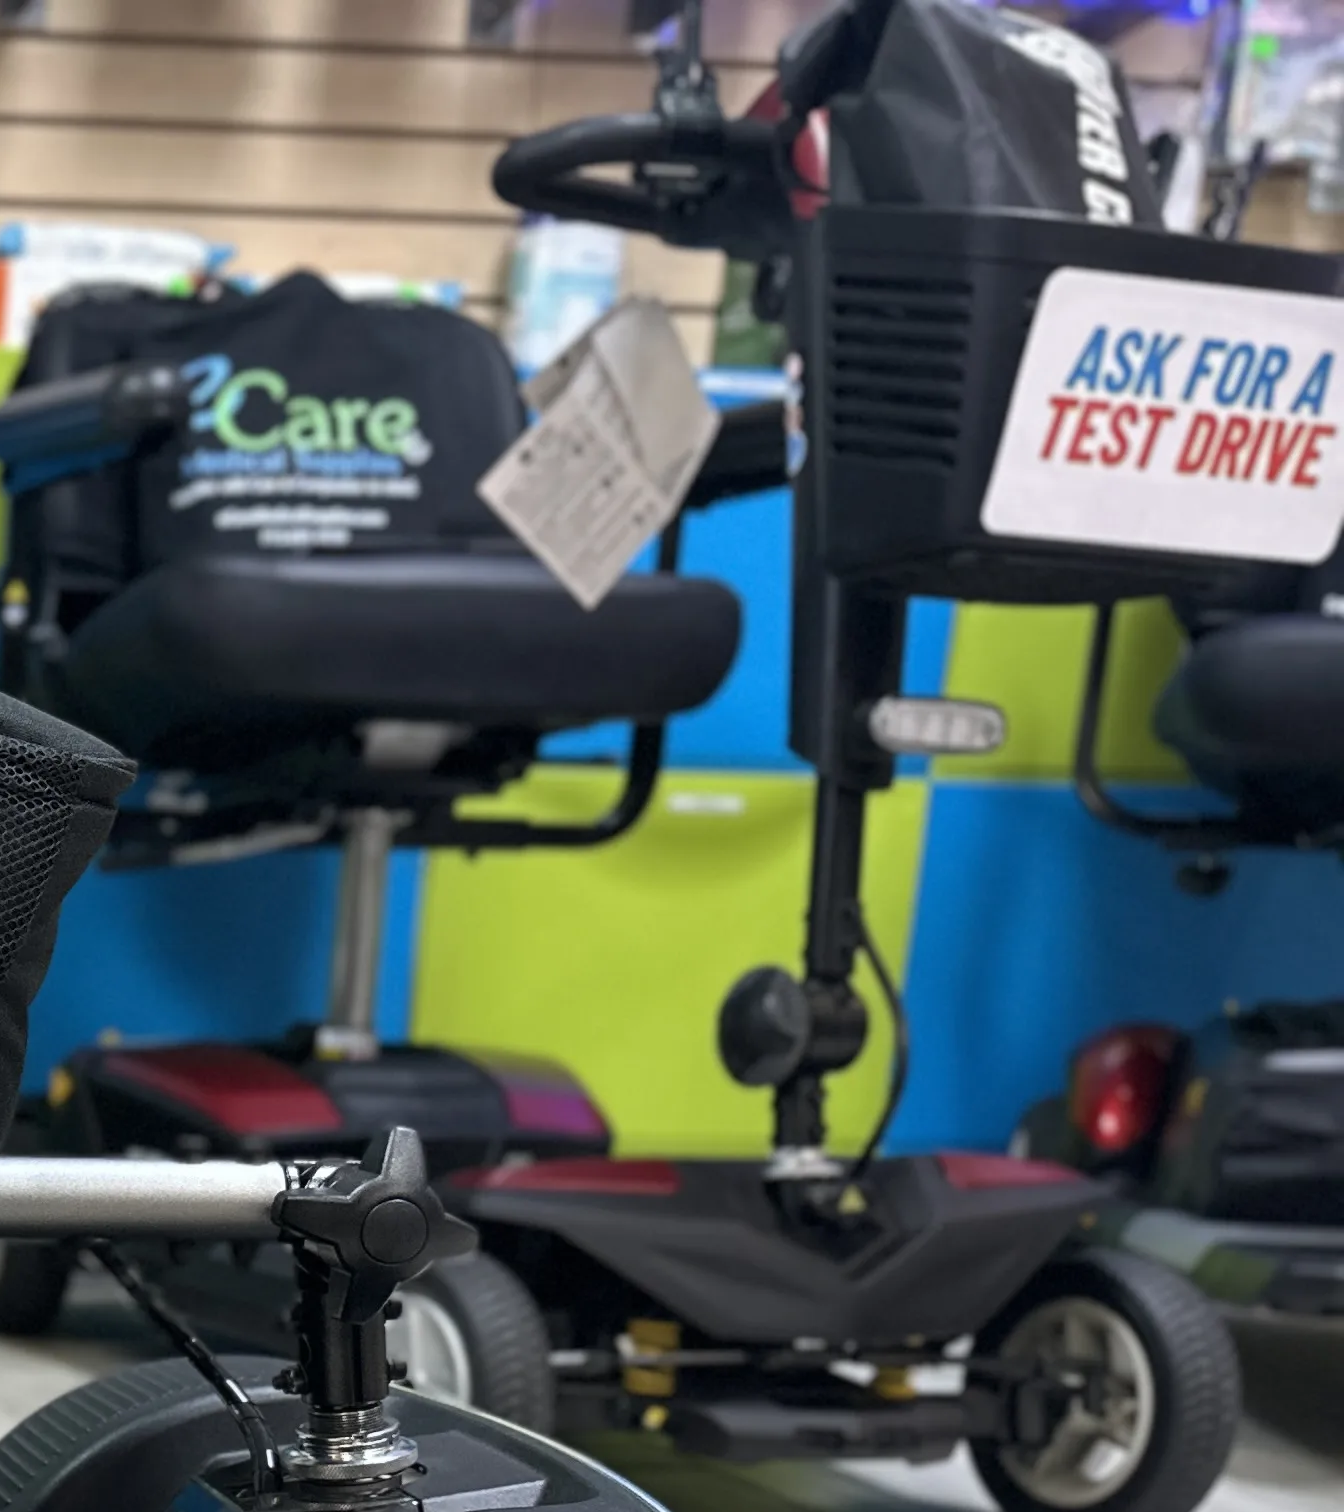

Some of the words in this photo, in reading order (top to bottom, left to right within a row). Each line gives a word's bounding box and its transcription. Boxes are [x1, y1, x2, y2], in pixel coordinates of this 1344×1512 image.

[1064, 324, 1183, 399] ASK
[1181, 337, 1290, 411] FOR
[1289, 350, 1335, 416] A
[1040, 395, 1176, 470] TEST
[1175, 410, 1337, 488] DRIVE
